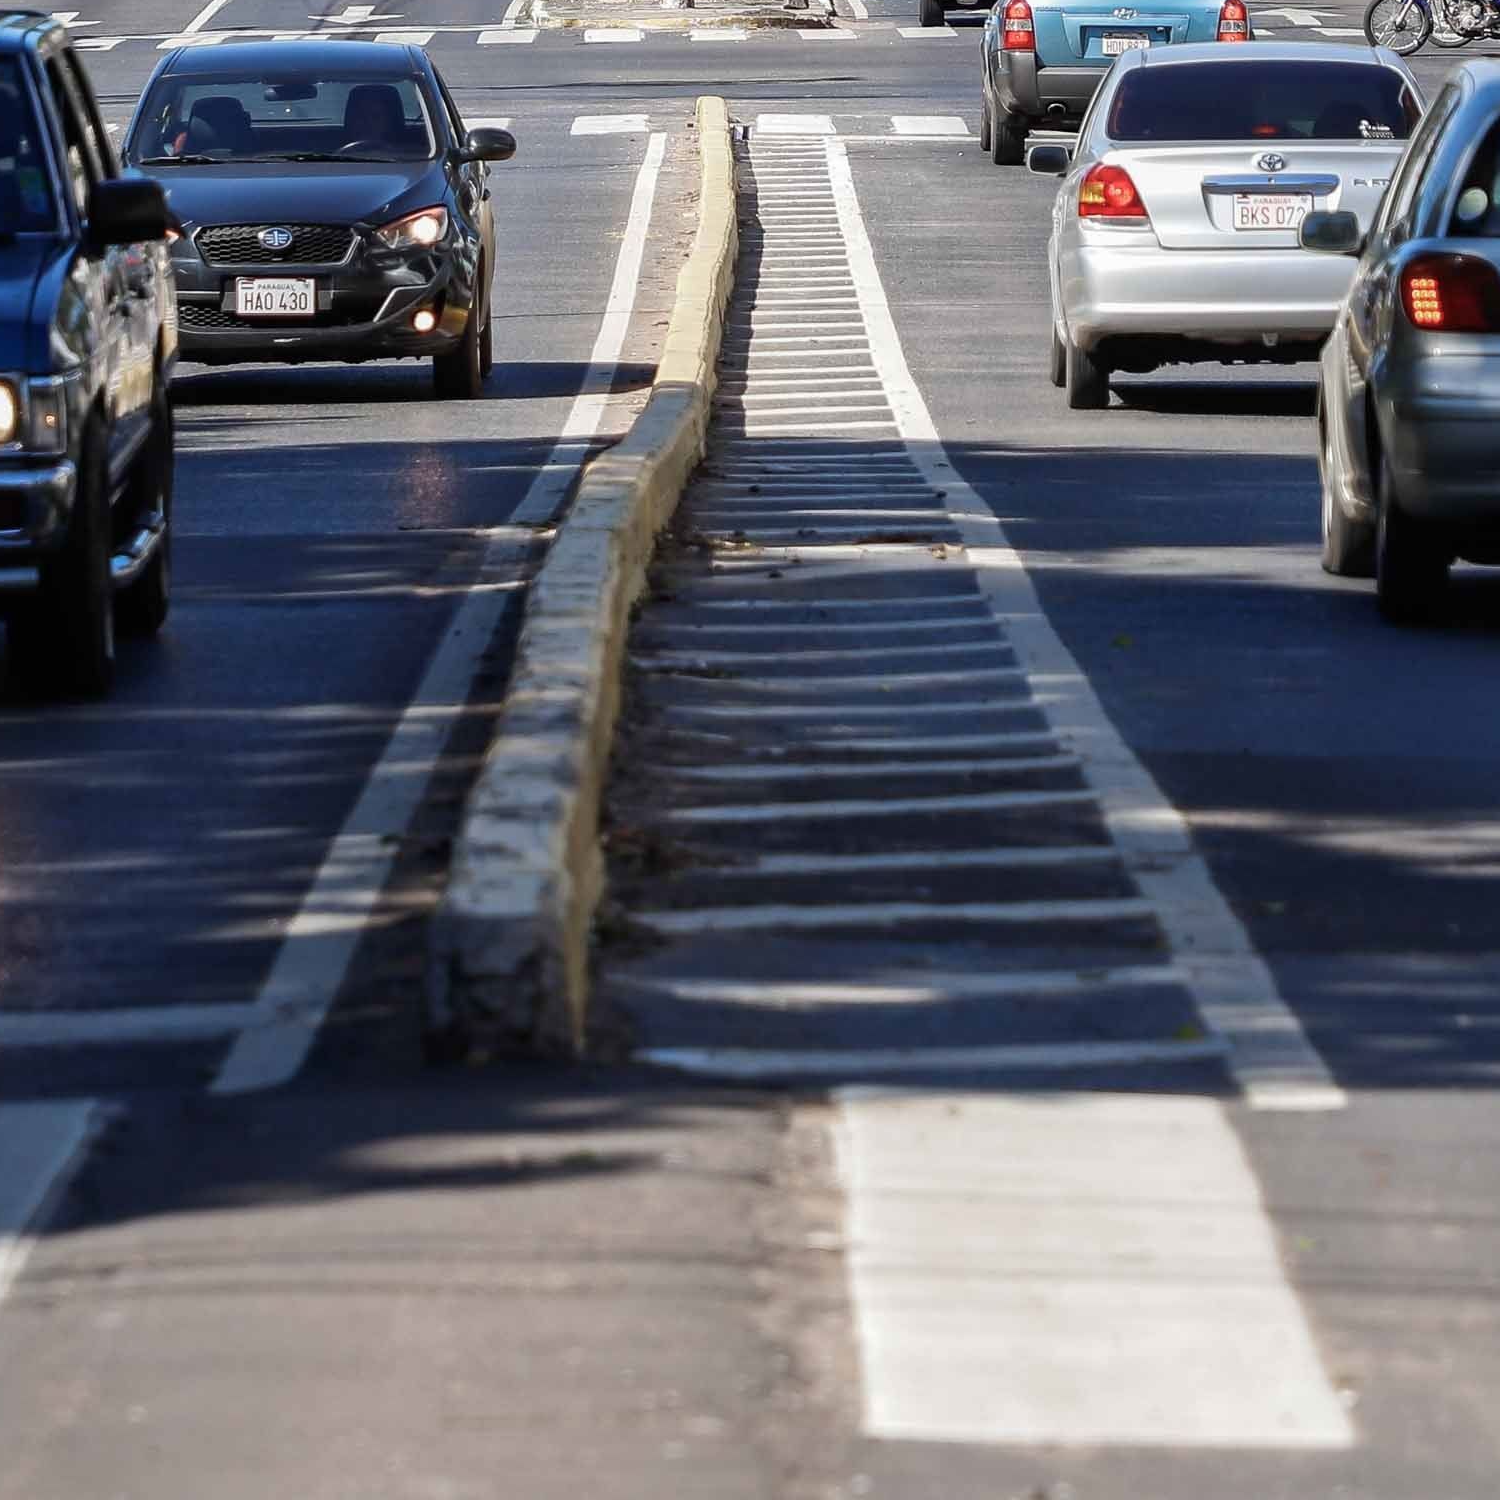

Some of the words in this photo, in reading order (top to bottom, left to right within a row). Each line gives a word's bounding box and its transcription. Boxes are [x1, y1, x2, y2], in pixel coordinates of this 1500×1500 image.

[1241, 206, 1270, 225] BKS
[257, 283, 296, 291] PARAGUAY
[280, 292, 308, 311] 430
